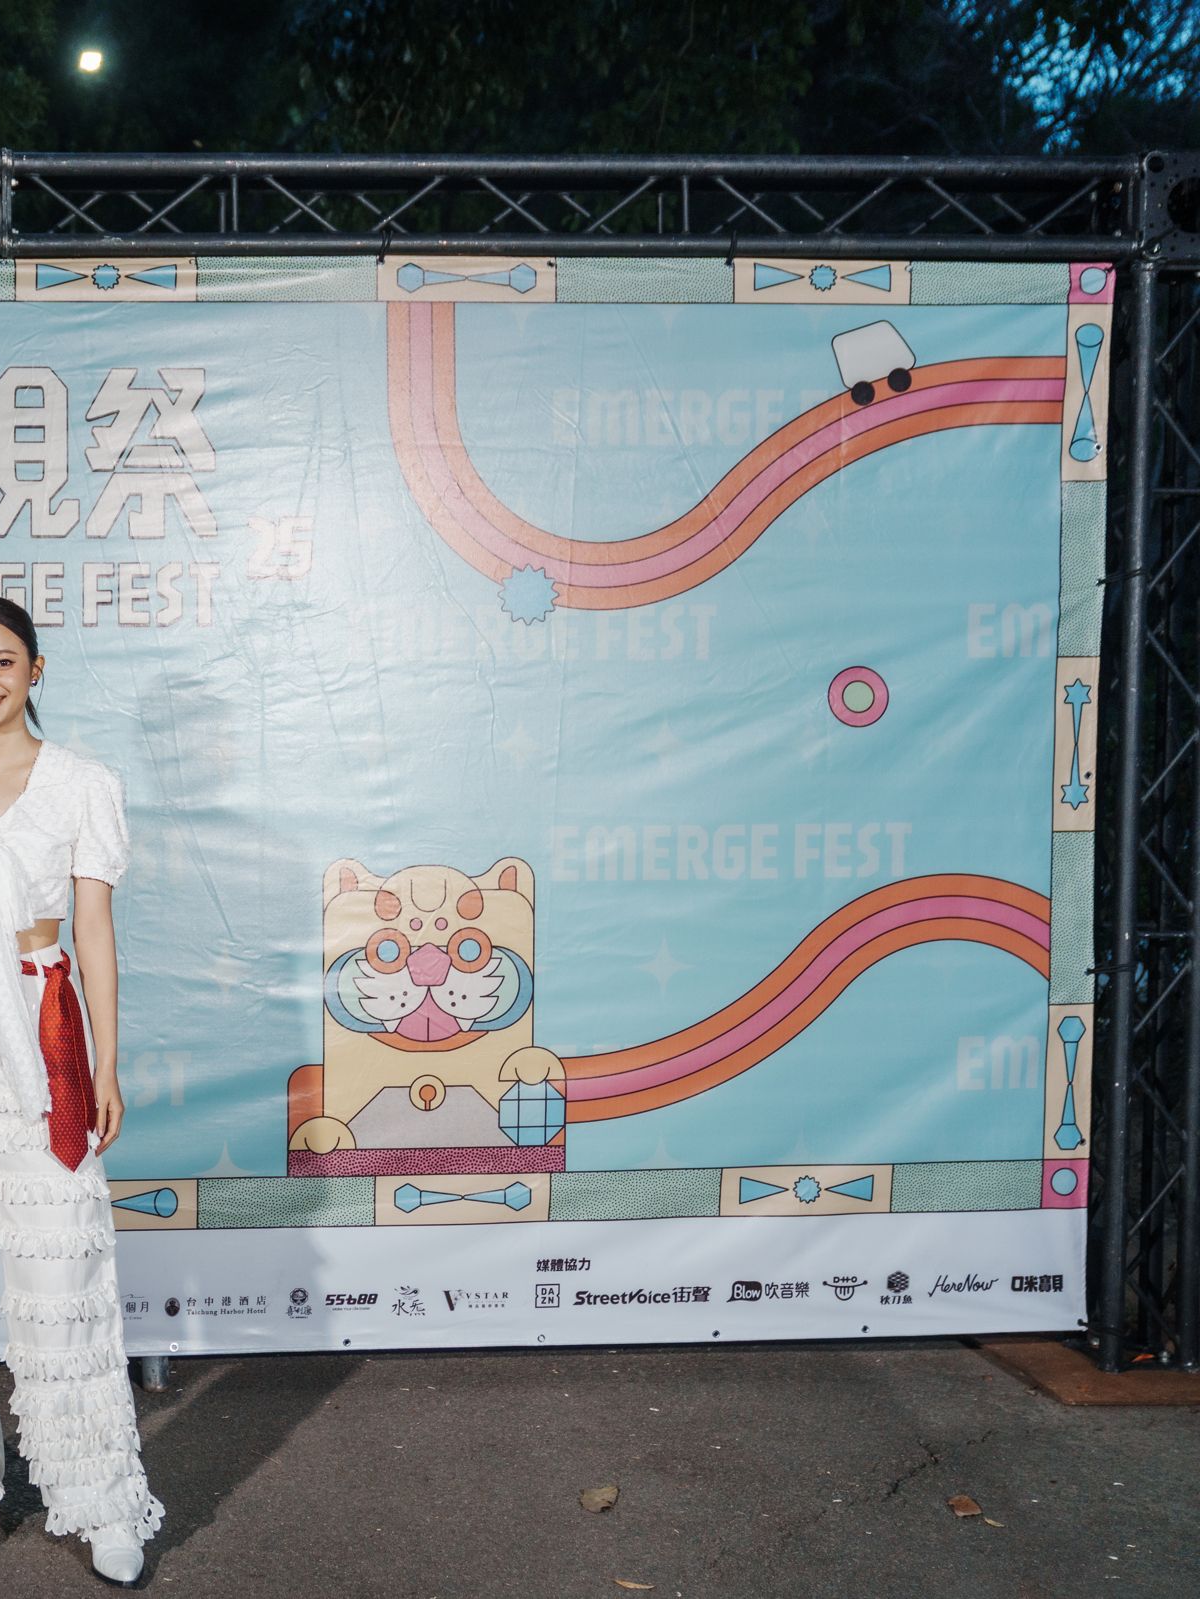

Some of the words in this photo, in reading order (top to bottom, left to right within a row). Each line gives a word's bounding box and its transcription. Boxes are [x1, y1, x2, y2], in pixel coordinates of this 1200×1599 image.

[246, 515, 316, 581] 25
[81, 561, 222, 628] FEST
[599, 603, 718, 661] FEST
[552, 825, 779, 882] EMERGE
[793, 822, 913, 879] FEST
[536, 1257, 591, 1273] 媒體協力
[734, 1283, 761, 1299] Blow
[765, 1281, 810, 1299] 吹音樂
[928, 1274, 1000, 1298] HereNow
[186, 1296, 267, 1307] 台中港酒店
[325, 1293, 379, 1306] 55688
[466, 1291, 509, 1301] VSTAR
[573, 1288, 671, 1306] StreetVoice
[880, 1295, 913, 1305] 秋刀魚
[186, 1309, 218, 1317] Taichung
